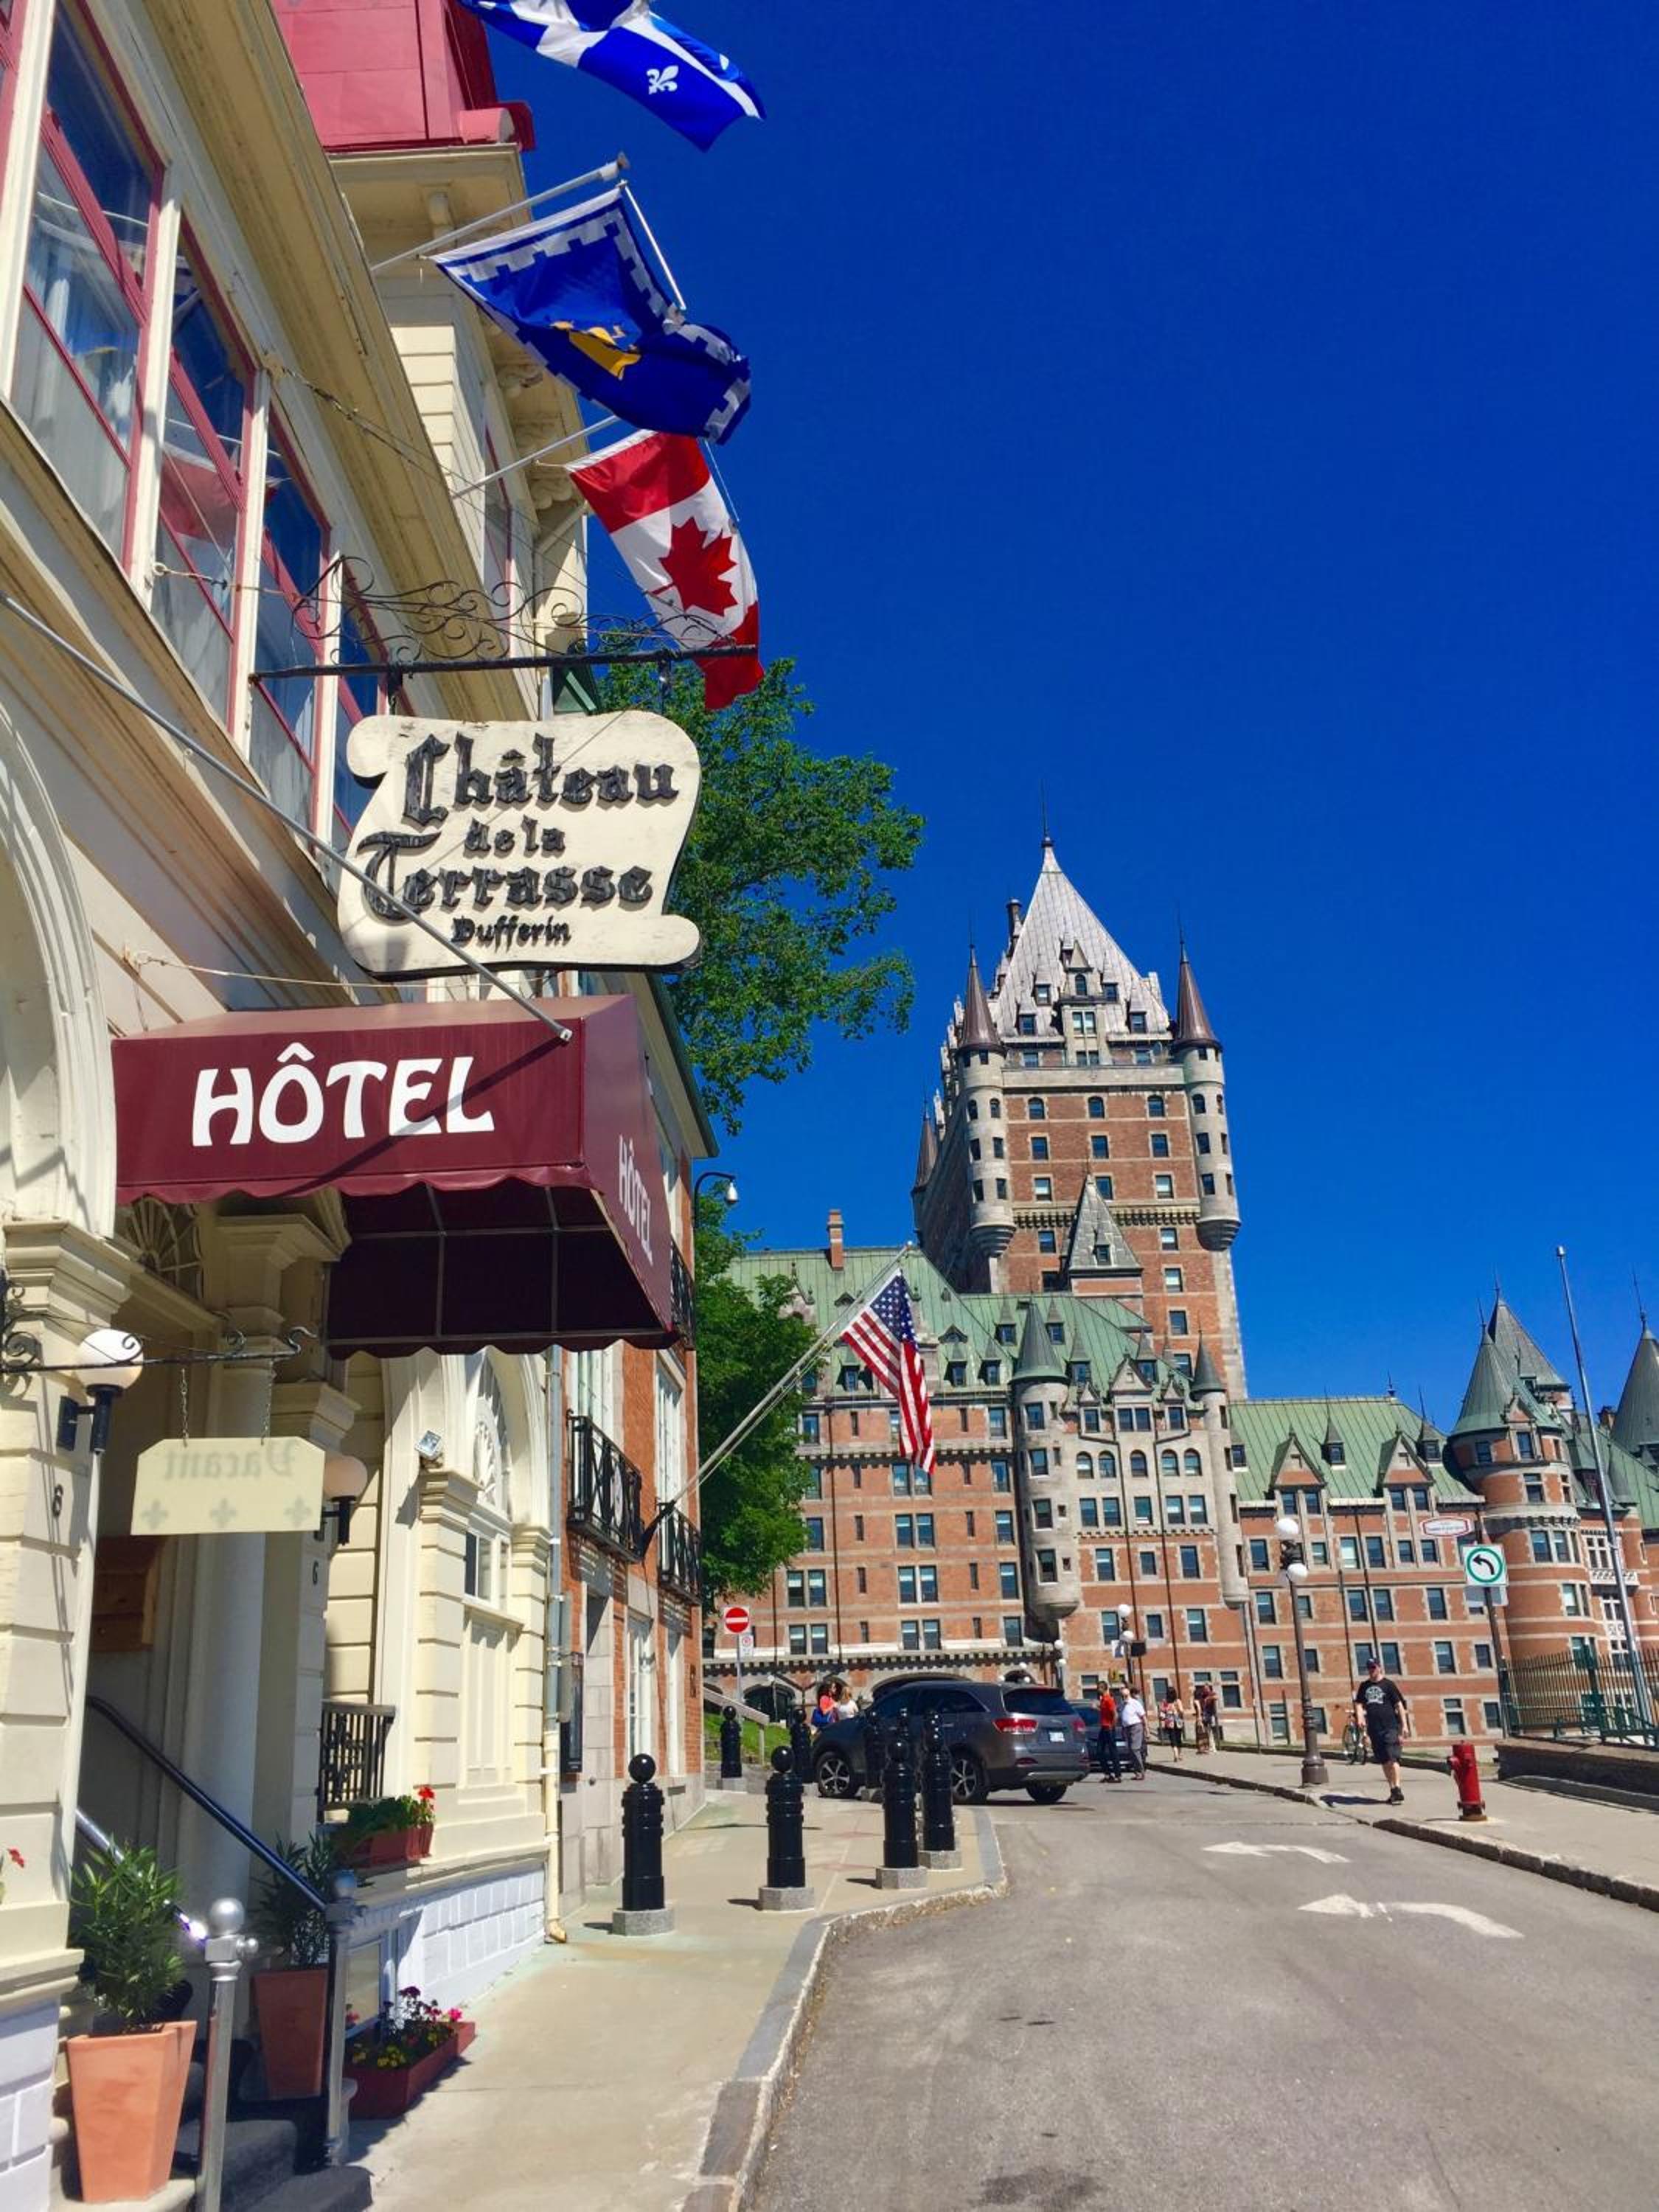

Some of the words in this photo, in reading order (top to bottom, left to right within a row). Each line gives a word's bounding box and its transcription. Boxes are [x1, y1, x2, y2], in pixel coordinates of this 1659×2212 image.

[403, 732, 679, 827] Château
[357, 831, 653, 920] Terrasse
[464, 816, 515, 852] de
[522, 815, 566, 852] la
[451, 916, 571, 953] Dufferin
[192, 1042, 495, 1147] HÔTEL
[619, 1134, 653, 1267] HÔTEL
[313, 1560, 319, 1585] 6
